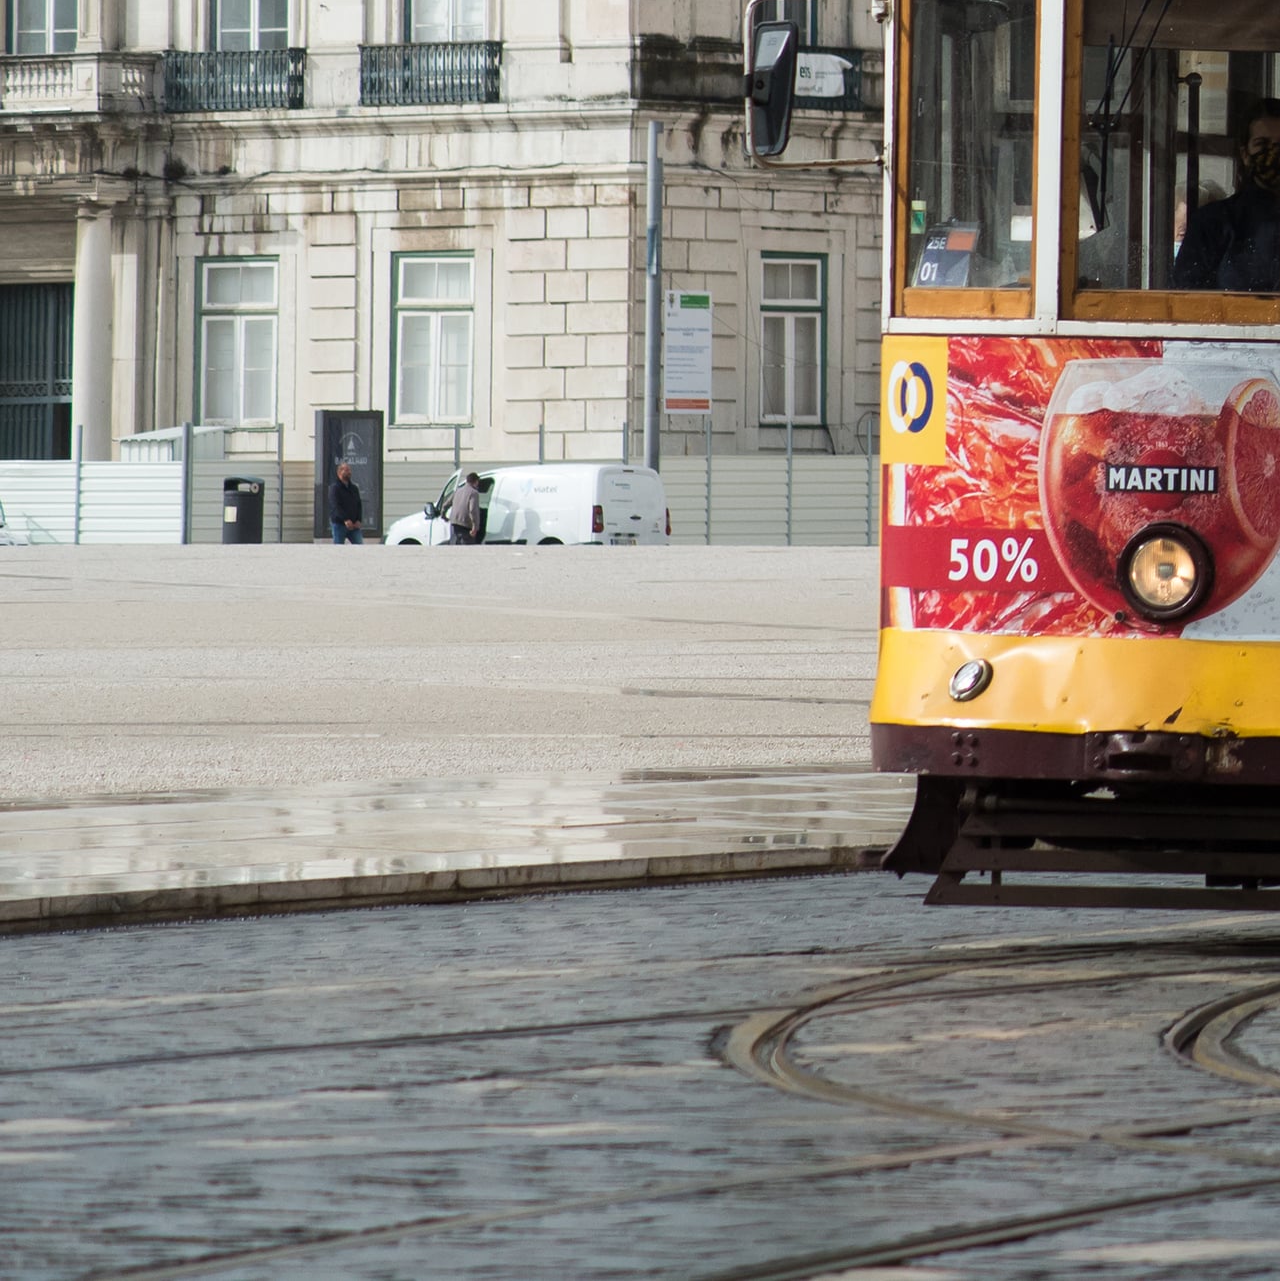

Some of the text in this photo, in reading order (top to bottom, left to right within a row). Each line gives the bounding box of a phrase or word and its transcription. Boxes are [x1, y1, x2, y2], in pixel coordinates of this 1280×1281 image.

[926, 236, 947, 250] 25E
[920, 262, 939, 281] 01
[1108, 467, 1215, 491] MARTINI
[948, 537, 1038, 583] 50%
